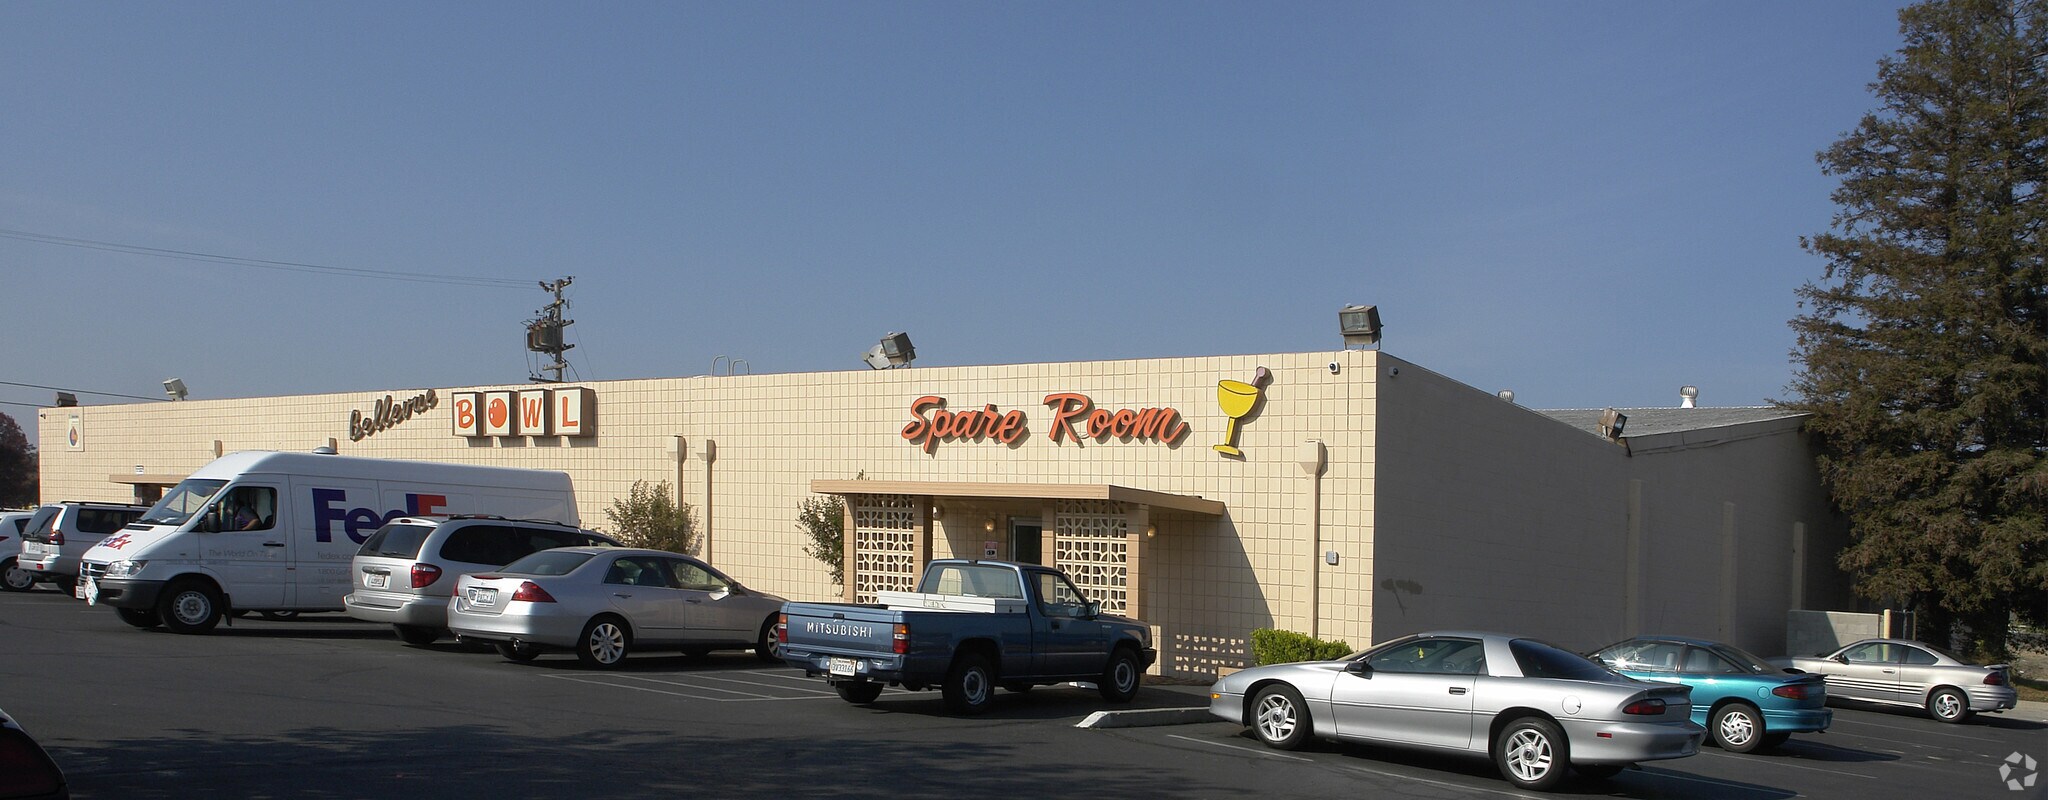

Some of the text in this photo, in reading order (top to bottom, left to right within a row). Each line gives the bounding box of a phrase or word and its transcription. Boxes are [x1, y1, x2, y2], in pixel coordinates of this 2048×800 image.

[456, 396, 578, 430] BOWL
[901, 393, 1190, 455] Spare Room
[806, 622, 872, 638] MITSUBISHI
